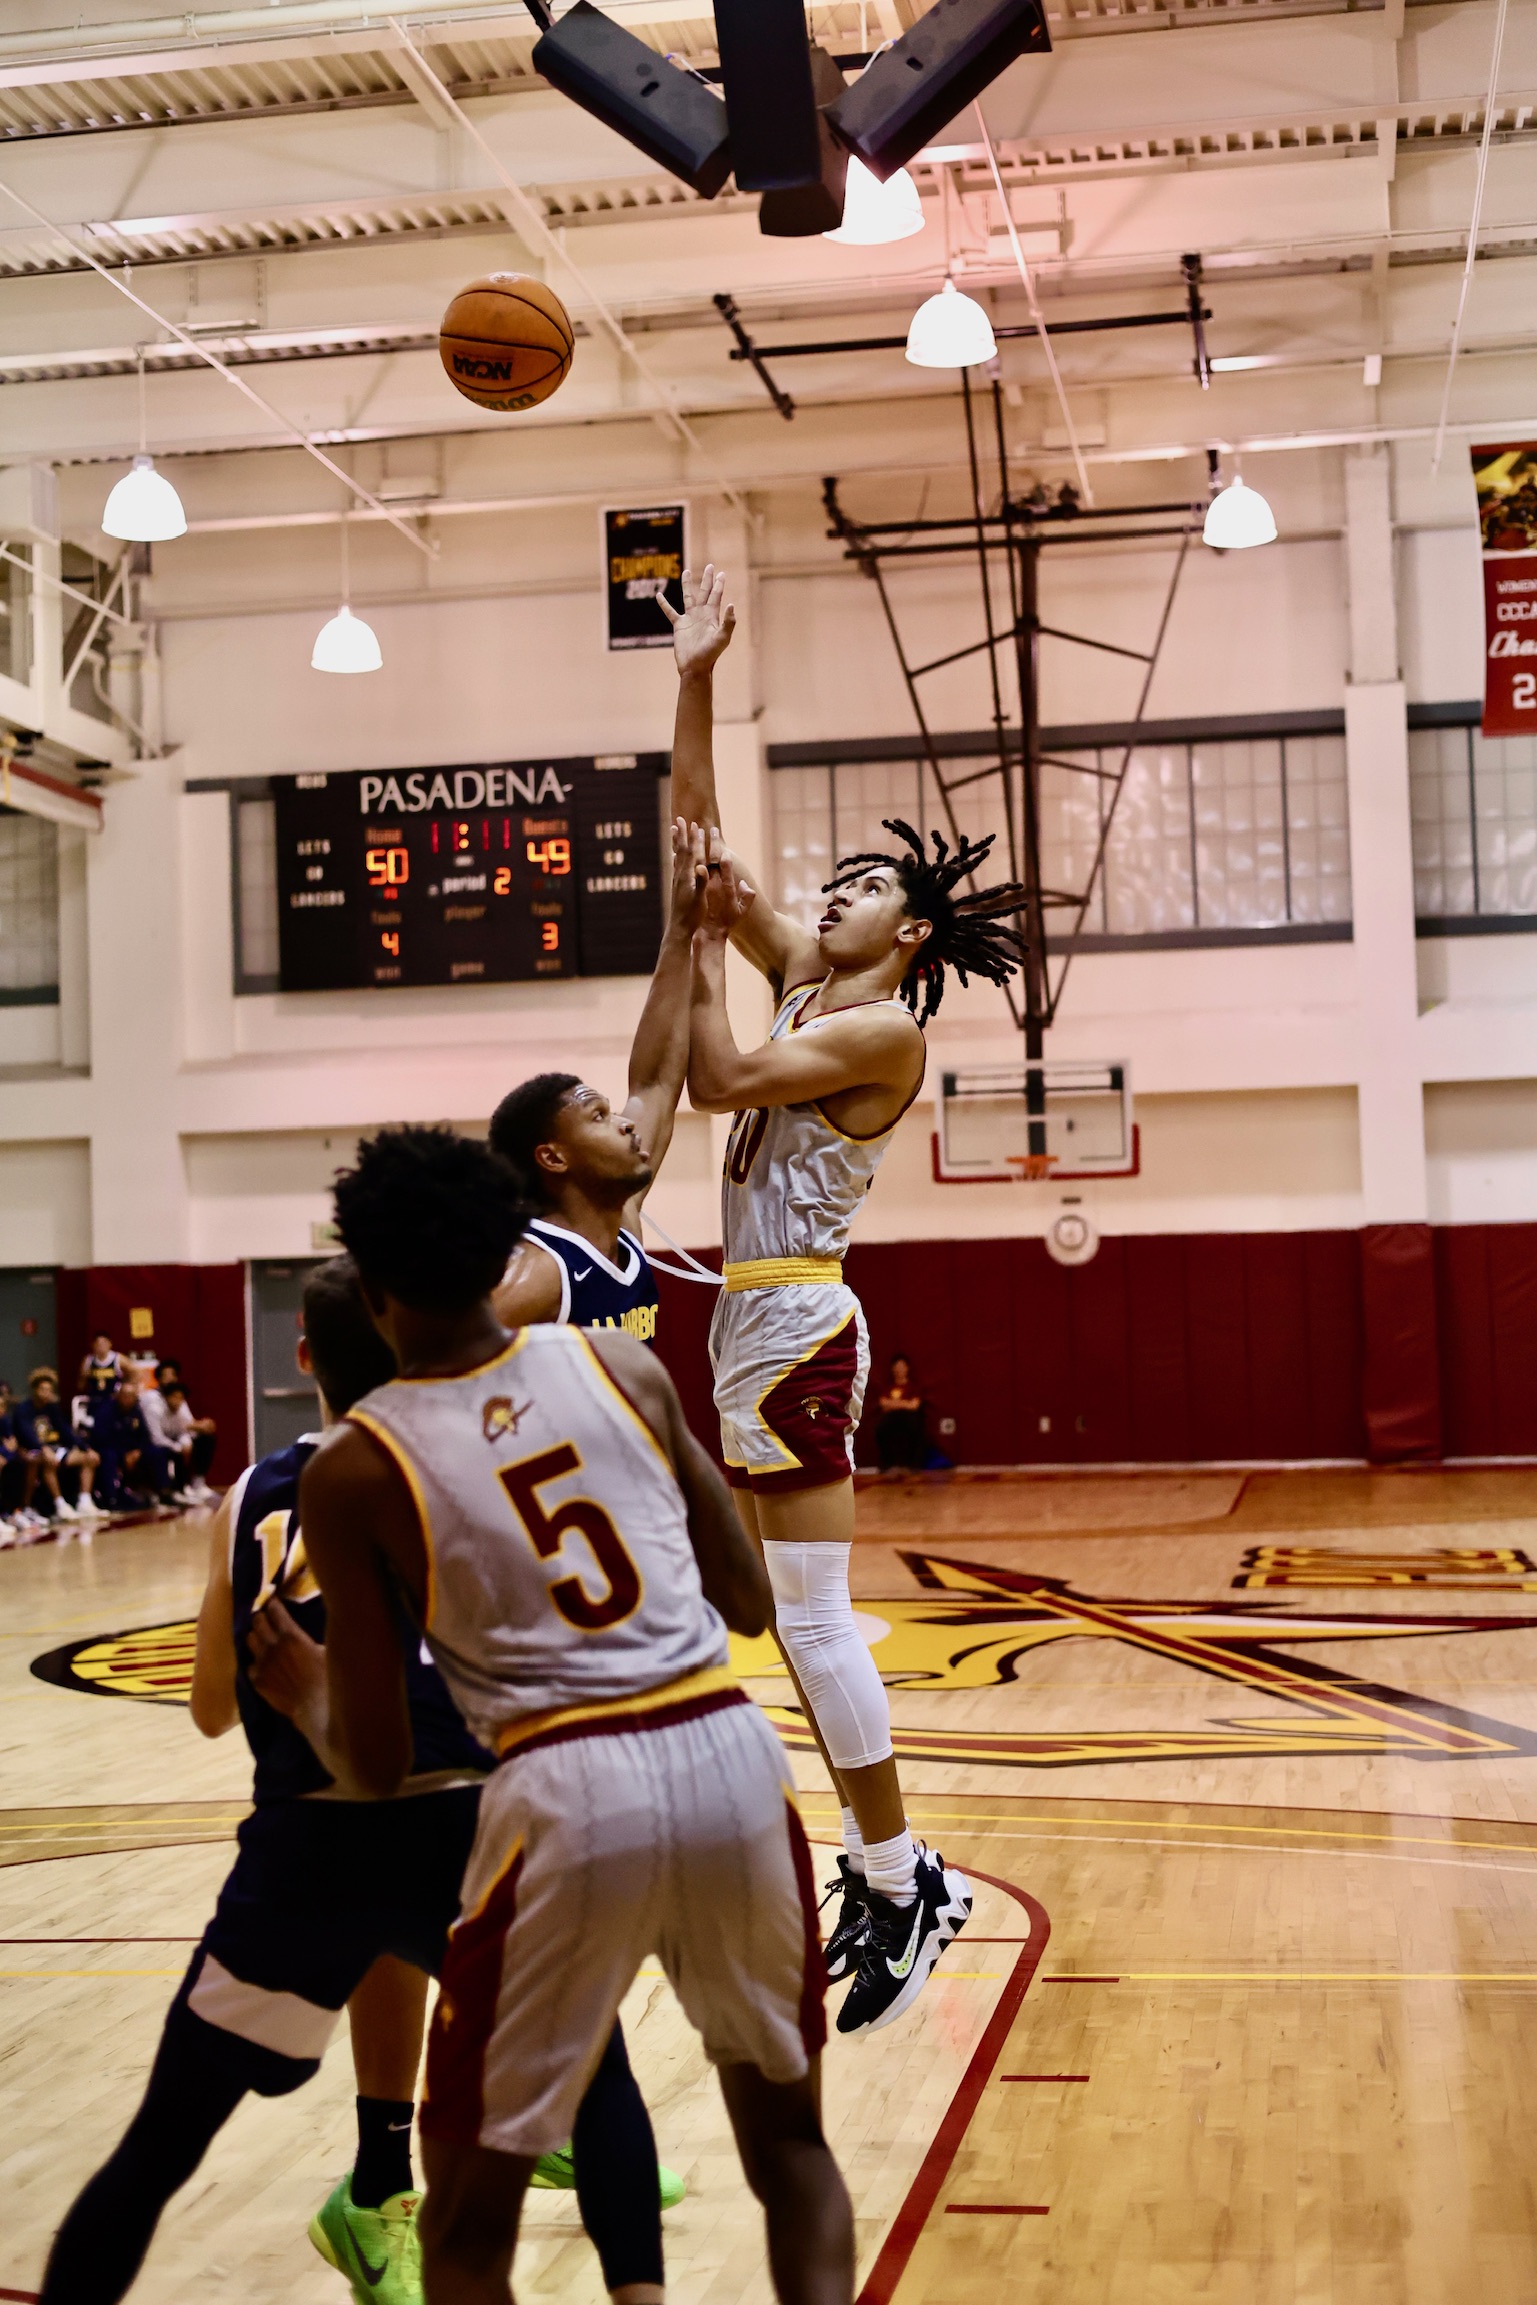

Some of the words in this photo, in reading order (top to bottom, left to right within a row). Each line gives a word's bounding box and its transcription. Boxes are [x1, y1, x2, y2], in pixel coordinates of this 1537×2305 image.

[452, 353, 513, 381] NCAA
[1511, 672, 1537, 710] 2
[359, 766, 567, 815] PASADENA
[366, 847, 410, 887] 50
[526, 838, 572, 876] 49
[494, 865, 512, 896] 2
[380, 932, 400, 958] 4
[541, 921, 560, 951] 3
[495, 1440, 644, 1635] 5
